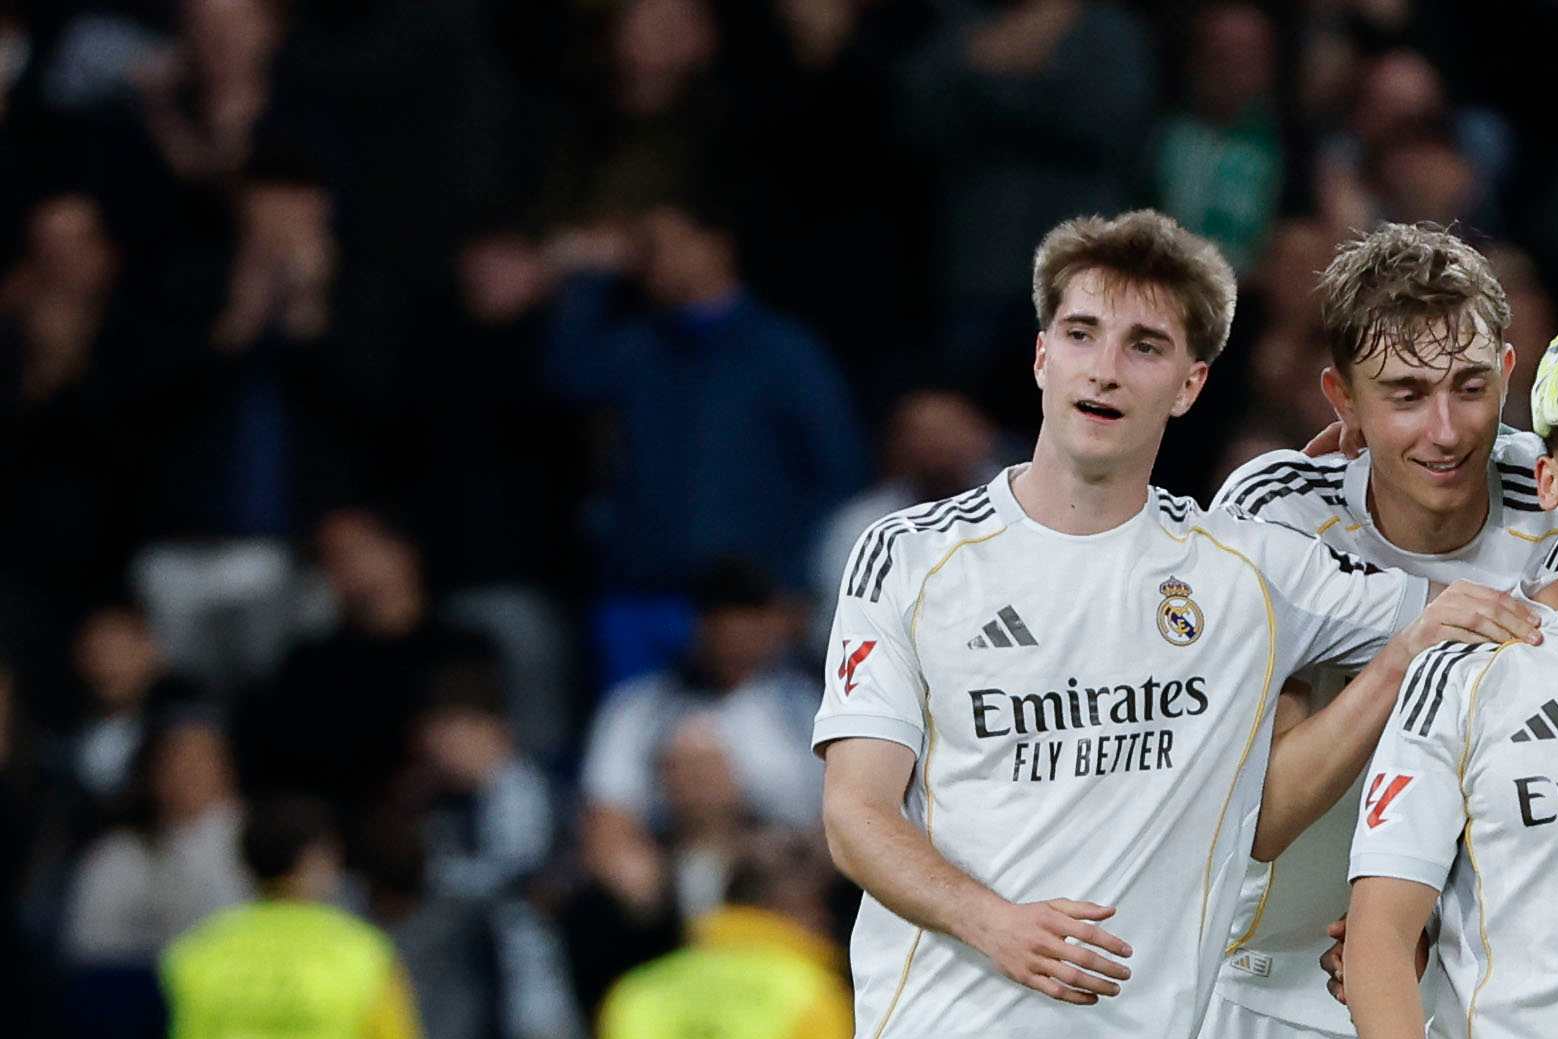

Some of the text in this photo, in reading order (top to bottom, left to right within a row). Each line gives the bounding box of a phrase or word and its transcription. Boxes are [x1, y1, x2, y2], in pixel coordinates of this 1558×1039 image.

[968, 675, 1209, 738] Emirates
[1012, 729, 1174, 782] FLY BETTER
